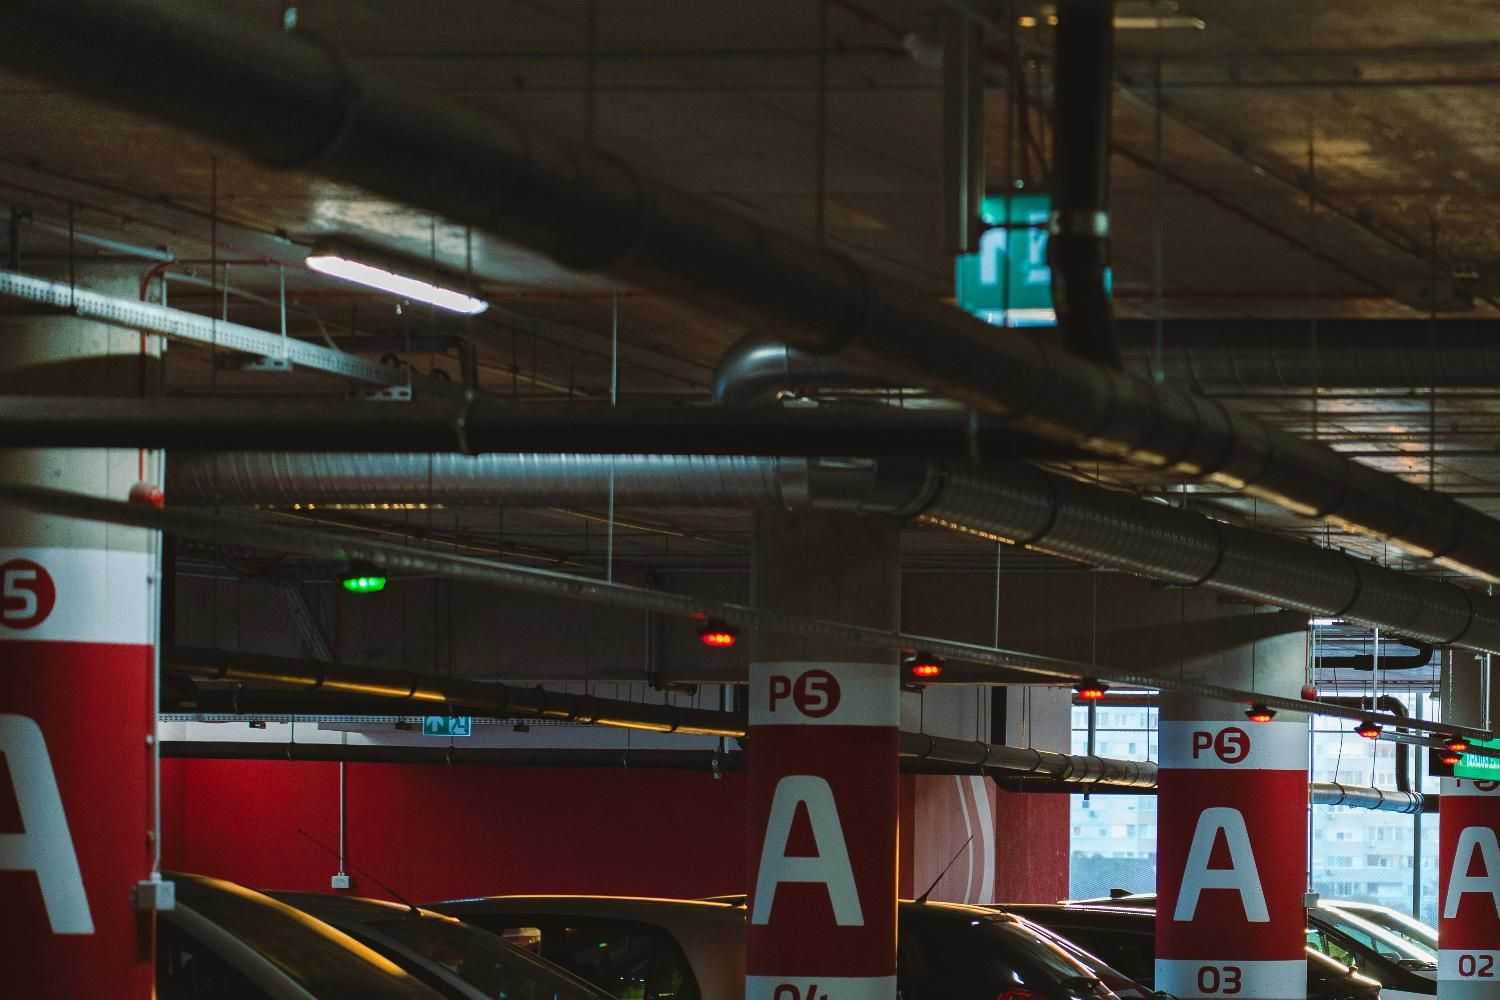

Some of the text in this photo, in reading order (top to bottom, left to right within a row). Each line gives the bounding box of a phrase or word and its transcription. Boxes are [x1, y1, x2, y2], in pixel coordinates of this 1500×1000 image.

[768, 671, 837, 716] P5
[1192, 728, 1249, 763] P5
[751, 774, 865, 927] A
[1173, 806, 1271, 923] A
[1197, 966, 1242, 994] 03
[1457, 954, 1495, 978] 02
